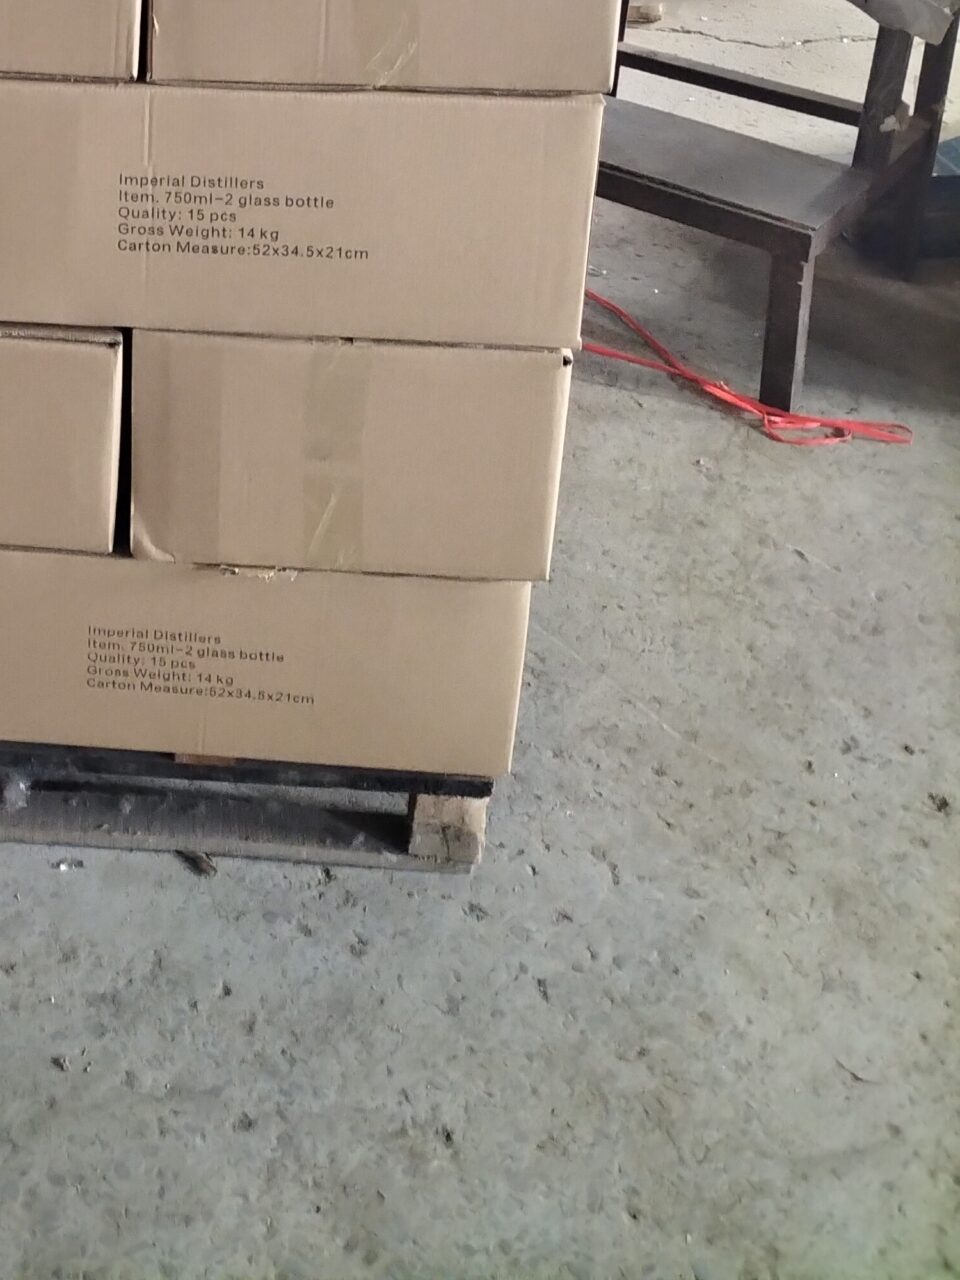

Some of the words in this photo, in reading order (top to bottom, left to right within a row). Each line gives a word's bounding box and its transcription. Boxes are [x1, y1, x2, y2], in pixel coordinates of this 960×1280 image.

[119, 173, 184, 189] Imperial
[191, 176, 264, 189] Distillers
[165, 191, 233, 205] 750ml-2
[239, 195, 280, 208] glass
[286, 196, 334, 209] bottle
[118, 207, 182, 221] Quality:
[188, 209, 204, 221] 15
[210, 211, 236, 223] pcs
[118, 223, 164, 236] Gross
[169, 225, 232, 240] Weight:
[238, 228, 255, 239] 14
[260, 228, 279, 241] kg
[118, 240, 171, 253] Carton
[89, 626, 148, 640] Imperial
[154, 630, 221, 645] Distillers
[88, 652, 144, 665] Quality:
[151, 656, 166, 667] 15
[171, 659, 196, 669] pcs
[197, 647, 235, 659] glass
[240, 650, 284, 662] bottle
[87, 665, 129, 678] Gross
[134, 668, 191, 682] Weight:
[197, 673, 211, 683] 14
[217, 675, 233, 686] kg
[87, 679, 135, 691] Carton
